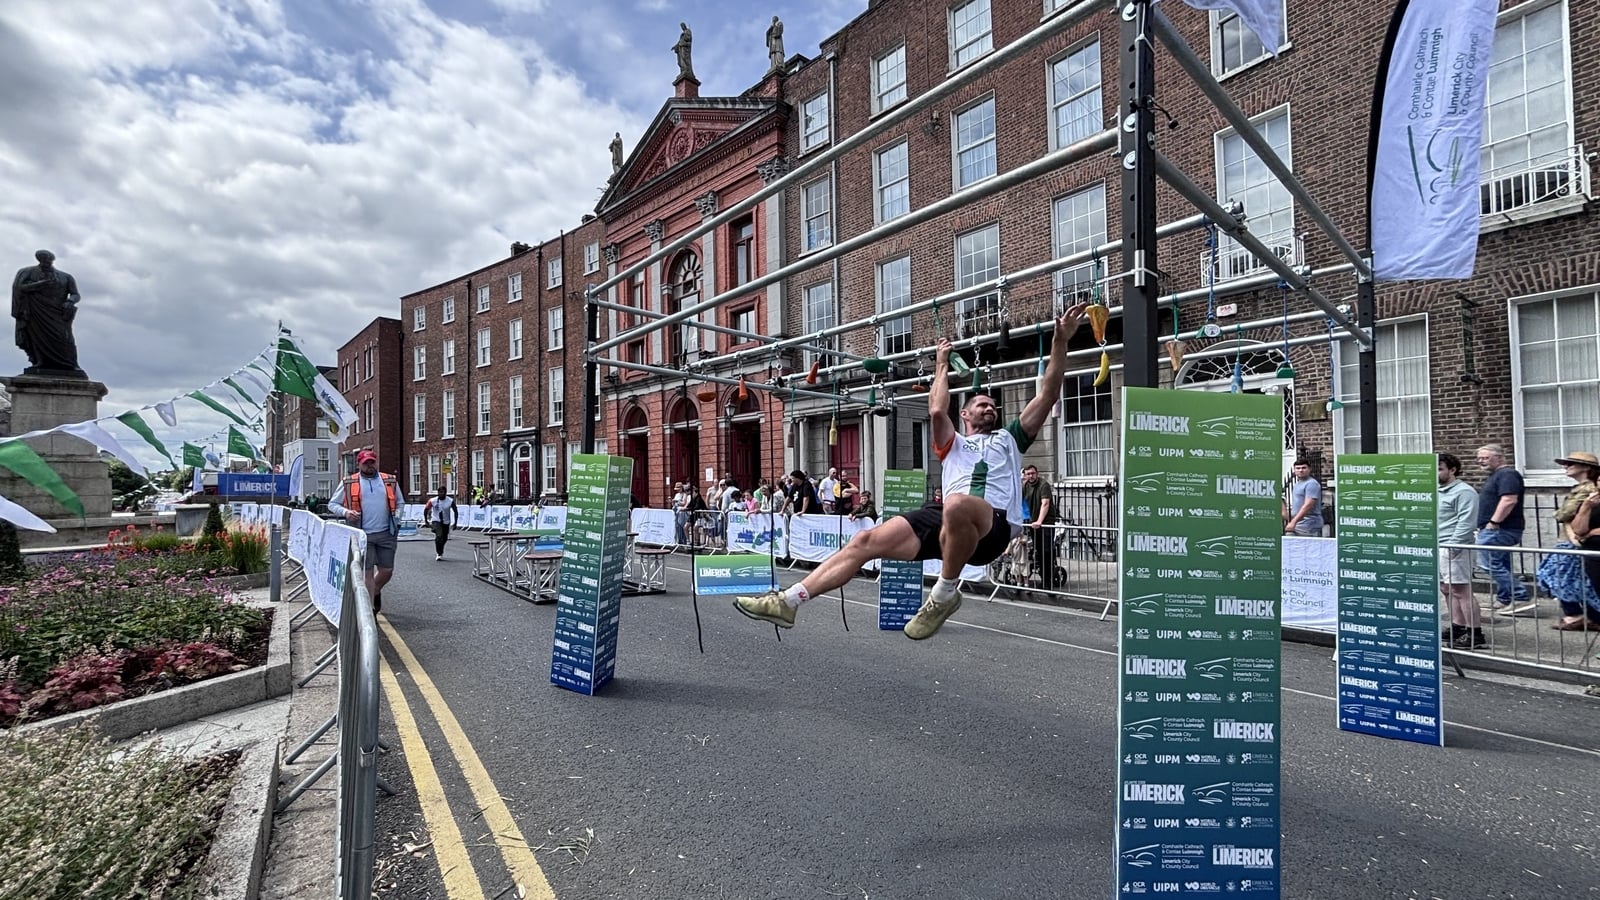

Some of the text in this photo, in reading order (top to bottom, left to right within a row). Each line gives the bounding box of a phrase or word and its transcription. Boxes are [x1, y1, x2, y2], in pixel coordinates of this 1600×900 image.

[1426, 28, 1443, 74] Luimnigh
[1466, 33, 1478, 69] Council
[1408, 27, 1428, 119] Comhairle Cathrach
[1448, 52, 1467, 114] Limerick City
[1461, 72, 1476, 106] County
[1423, 76, 1436, 109] Contae
[1130, 414, 1190, 432] LIMERICK
[1159, 448, 1184, 457] UIPM
[1340, 465, 1376, 474] LIMERICK
[234, 482, 277, 492] LIMERICK
[1217, 478, 1275, 496] LIMERICK
[1393, 491, 1432, 501] LIMERICK
[1158, 508, 1183, 517] UIPM
[1340, 518, 1376, 527] LIMERICK
[1127, 535, 1187, 553] LIMERICK
[1394, 545, 1433, 556] LIMERICK
[700, 568, 731, 577] LIMERICK
[1157, 569, 1182, 578] UIPM
[1294, 568, 1333, 578] Cathrach
[1340, 569, 1376, 580] LIMERICK
[1290, 576, 1333, 586] Luimnigh
[1289, 590, 1306, 598] City
[1215, 599, 1274, 616] LIMERICK
[1290, 598, 1324, 607] Council
[1394, 600, 1434, 613] LIMERICK
[1156, 630, 1182, 639] UIPM
[1340, 622, 1377, 635] LIMERICK
[1126, 658, 1186, 676] LIMERICK
[1395, 655, 1434, 669] LIMERICK
[1341, 676, 1378, 690] LIMERICK
[1156, 693, 1181, 702] UIPM
[1396, 711, 1435, 726] LIMERICK
[1214, 722, 1274, 739] LIMERICK
[1155, 755, 1180, 764] UIPM
[1124, 784, 1184, 801] LIMERICK
[1154, 819, 1179, 828] UIPM
[1213, 848, 1273, 865] LIMERICK
[1153, 883, 1179, 892] UIPM
